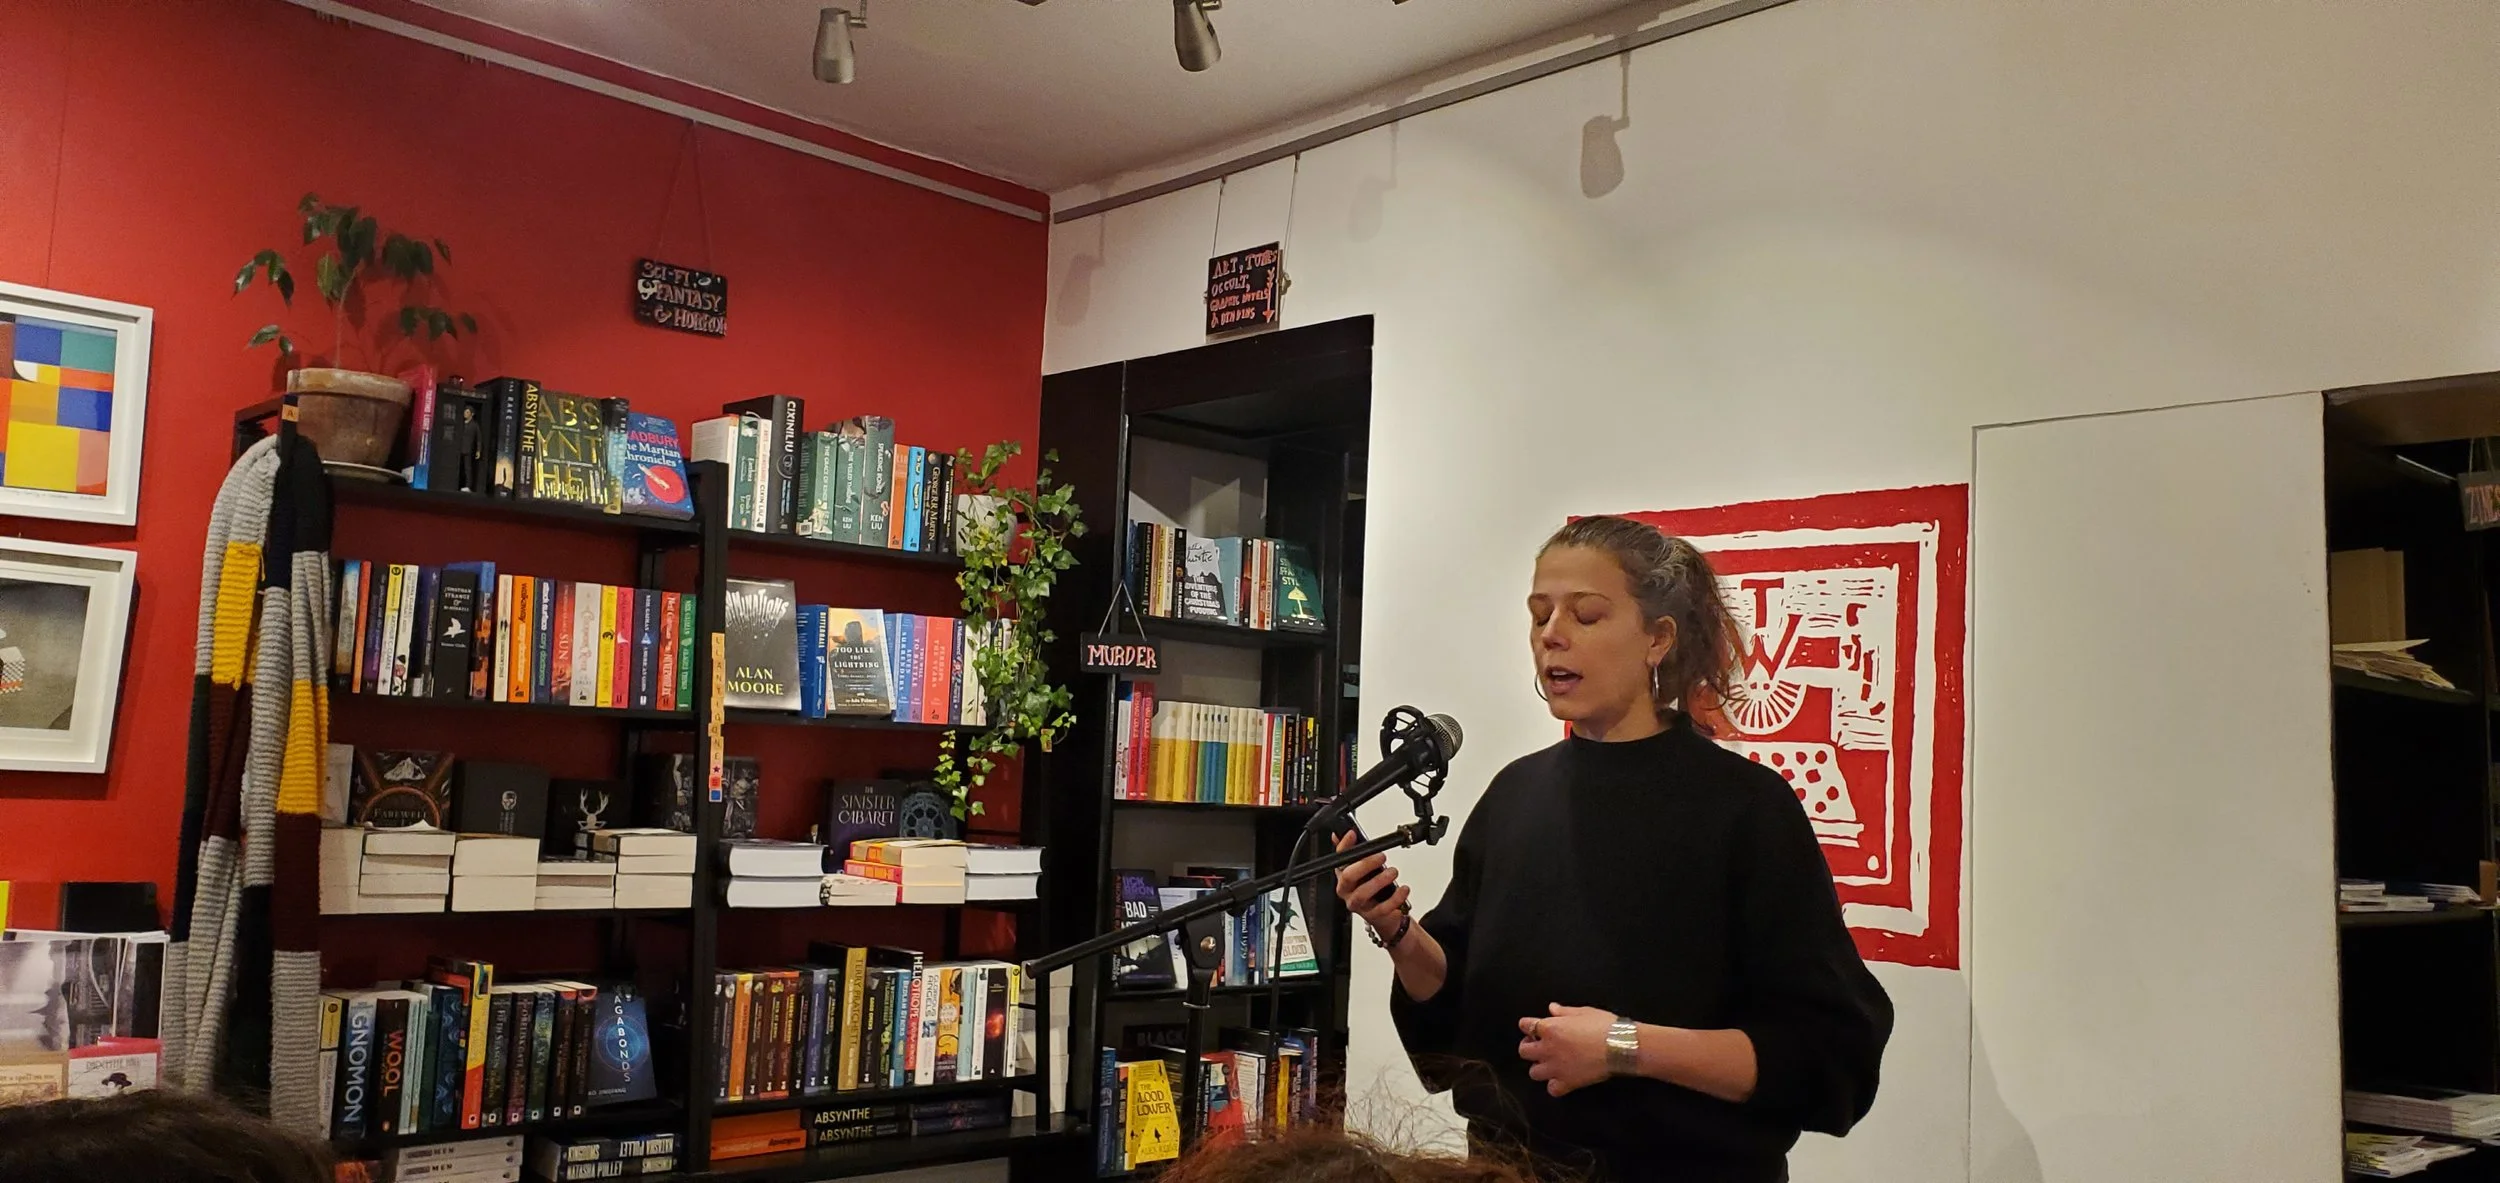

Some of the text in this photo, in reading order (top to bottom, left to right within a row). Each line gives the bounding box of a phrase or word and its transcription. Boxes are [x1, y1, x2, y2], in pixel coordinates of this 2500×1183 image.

[641, 261, 690, 286] SCI-FI
[656, 282, 722, 312] FANTASY
[521, 383, 539, 453] ABSYNTHE
[627, 430, 679, 449] ADBURY
[638, 442, 681, 459] Martian
[876, 442, 885, 472] SPEAKING
[931, 466, 941, 495] GEORGE
[870, 515, 884, 523] KEN
[871, 522, 883, 530] LIU
[928, 511, 937, 541] MARTIN
[1184, 583, 1218, 593] ADVENTURE
[517, 582, 529, 624] walkaway
[1184, 597, 1221, 608] CHRISTMAS
[1741, 577, 1785, 629] T
[558, 632, 570, 661] SUN
[836, 646, 875, 654] TOO LIKE
[1087, 643, 1158, 669] MURDER
[1726, 613, 1804, 680] W
[735, 666, 773, 680] ALAN
[834, 660, 880, 669] LIGHTNING
[898, 631, 908, 691] SURRENDERS
[912, 637, 920, 688] TO BATTLE
[727, 681, 784, 696] MOORE
[373, 807, 427, 820] FAREWELL
[841, 795, 895, 811] SINISTER
[838, 810, 895, 826] CABARET
[1125, 901, 1147, 919] BAD
[910, 956, 923, 1019] HELIOTROPE
[925, 975, 934, 1018] ANGELS
[931, 974, 940, 1017] GLORIOUS
[849, 957, 864, 1046] TERRY PRATCHETT
[899, 980, 910, 1037] BEDLAM STACKS
[613, 994, 631, 1083] AGABONDS
[343, 1011, 370, 1123] GNOMON
[383, 1029, 405, 1097] WOOL
[814, 1107, 871, 1124] ABSYNTHE
[1136, 1102, 1172, 1117] LOWER
[819, 1124, 874, 1141] ABSYNTHE
[432, 1164, 453, 1172] MEN
[597, 1160, 623, 1178] PULLEY
